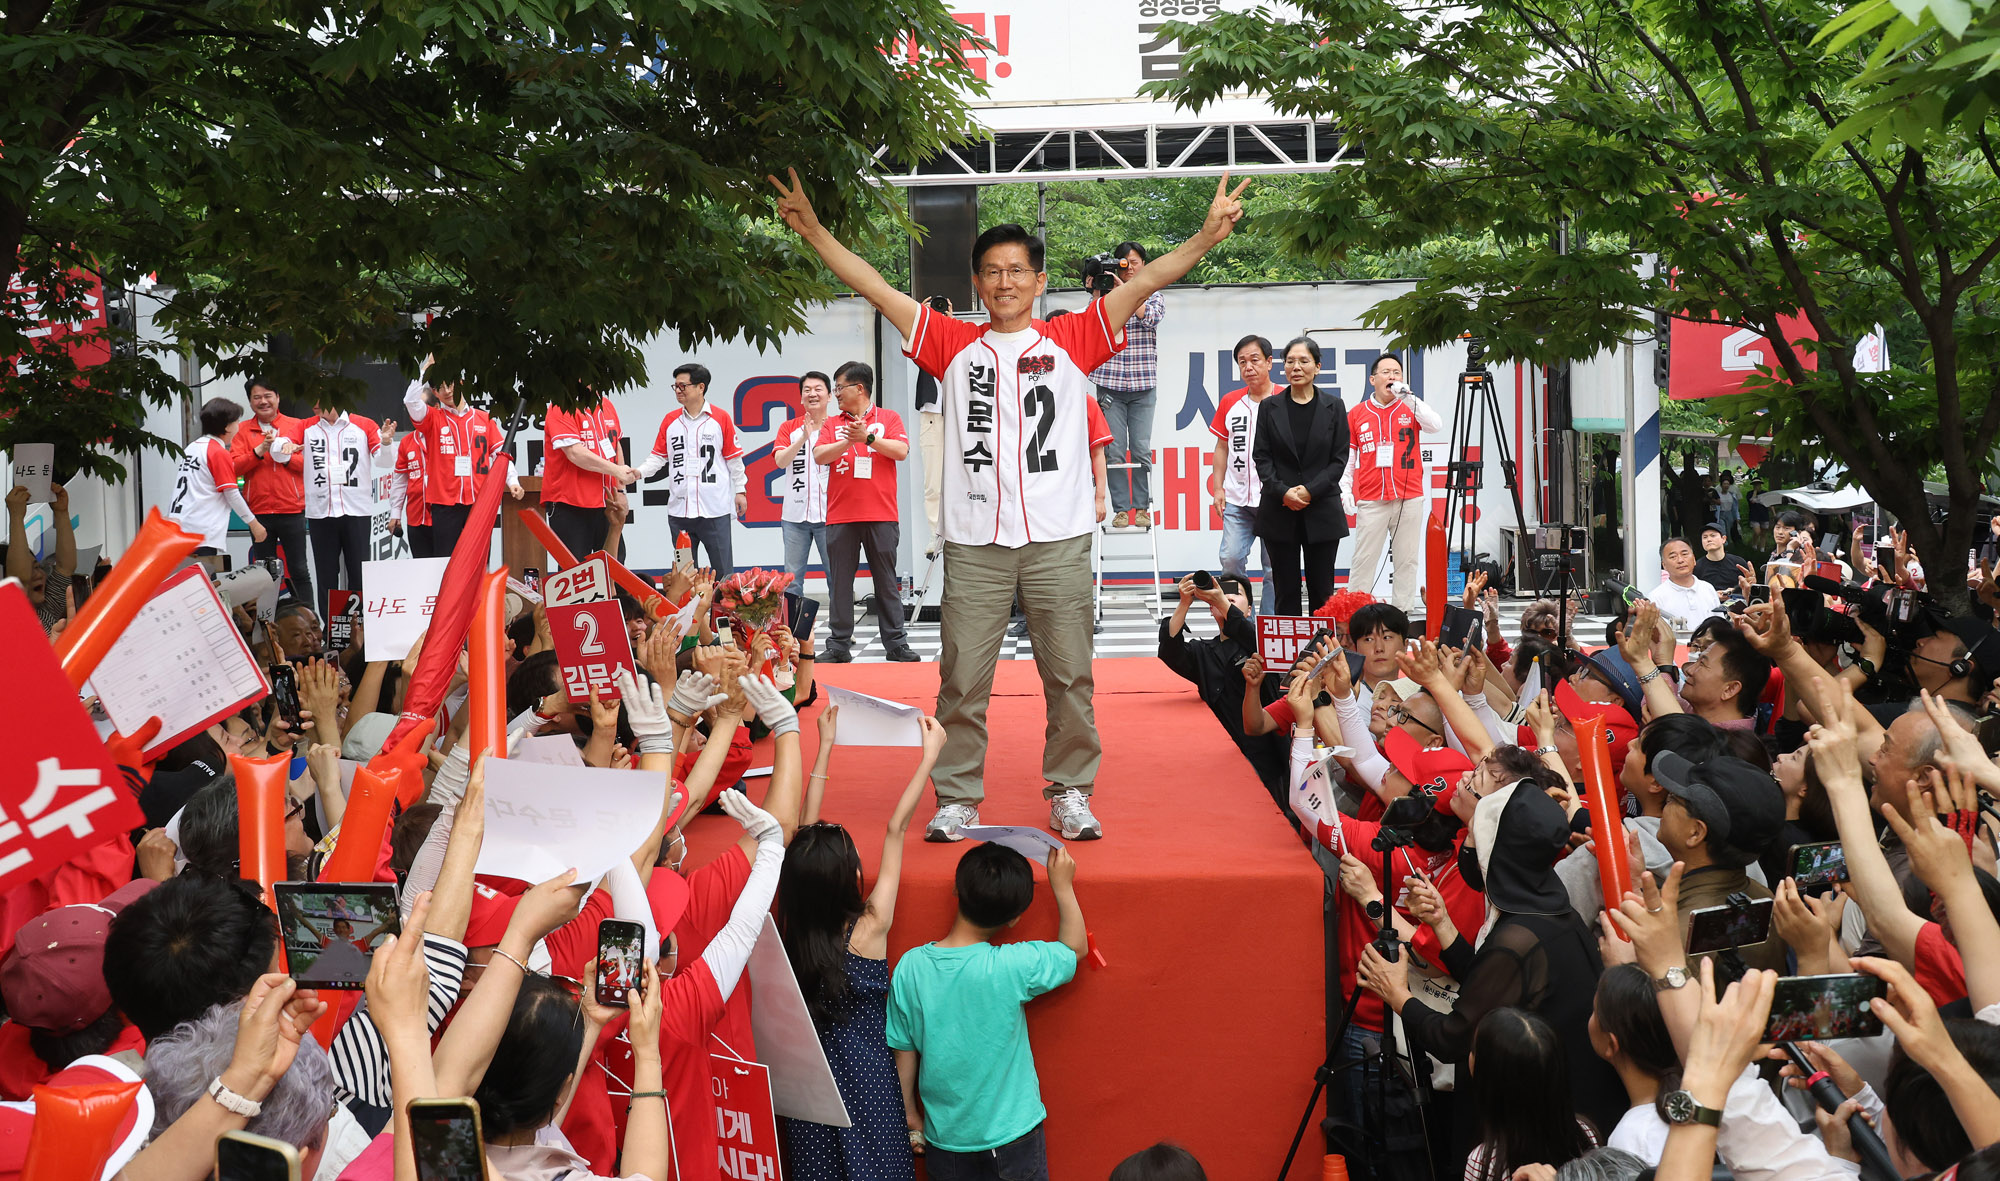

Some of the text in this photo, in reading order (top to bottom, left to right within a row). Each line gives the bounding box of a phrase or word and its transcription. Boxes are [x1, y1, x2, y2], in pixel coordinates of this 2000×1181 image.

[963, 361, 996, 473] 김문수
[1023, 385, 1059, 474] 2
[310, 438, 327, 488] 김문수
[474, 434, 489, 475] 2
[671, 434, 685, 486] 김문수
[700, 444, 717, 484] 2
[1231, 415, 1248, 473] 김문수
[1398, 427, 1416, 470] 2
[15, 465, 37, 477] 나도
[178, 455, 201, 474] 문수
[342, 447, 359, 487] 2
[170, 476, 188, 514] 2
[554, 565, 596, 602] 2번
[1911, 568, 1919, 577] 2
[347, 593, 361, 616] 2
[367, 597, 407, 618] 나도
[331, 623, 352, 639] 김문
[573, 610, 607, 657] 2
[1421, 775, 1448, 798] 2
